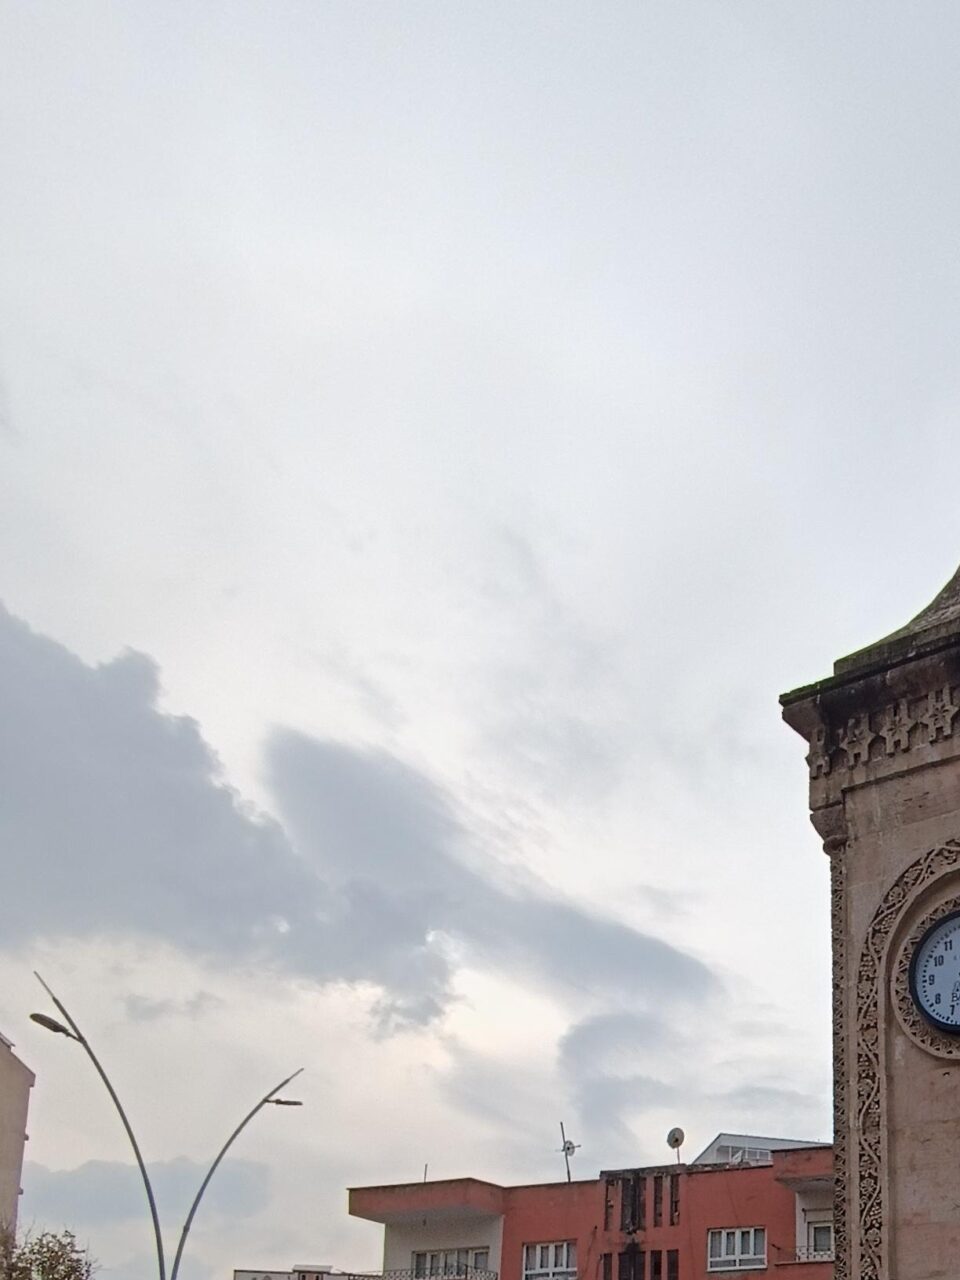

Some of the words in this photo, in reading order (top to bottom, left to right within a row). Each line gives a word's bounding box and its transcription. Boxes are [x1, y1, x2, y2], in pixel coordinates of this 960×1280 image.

[944, 940, 953, 951] 11
[934, 955, 944, 967] 10
[928, 974, 935, 985] 9
[935, 993, 942, 1004] 8
[949, 1005, 956, 1015] 7
